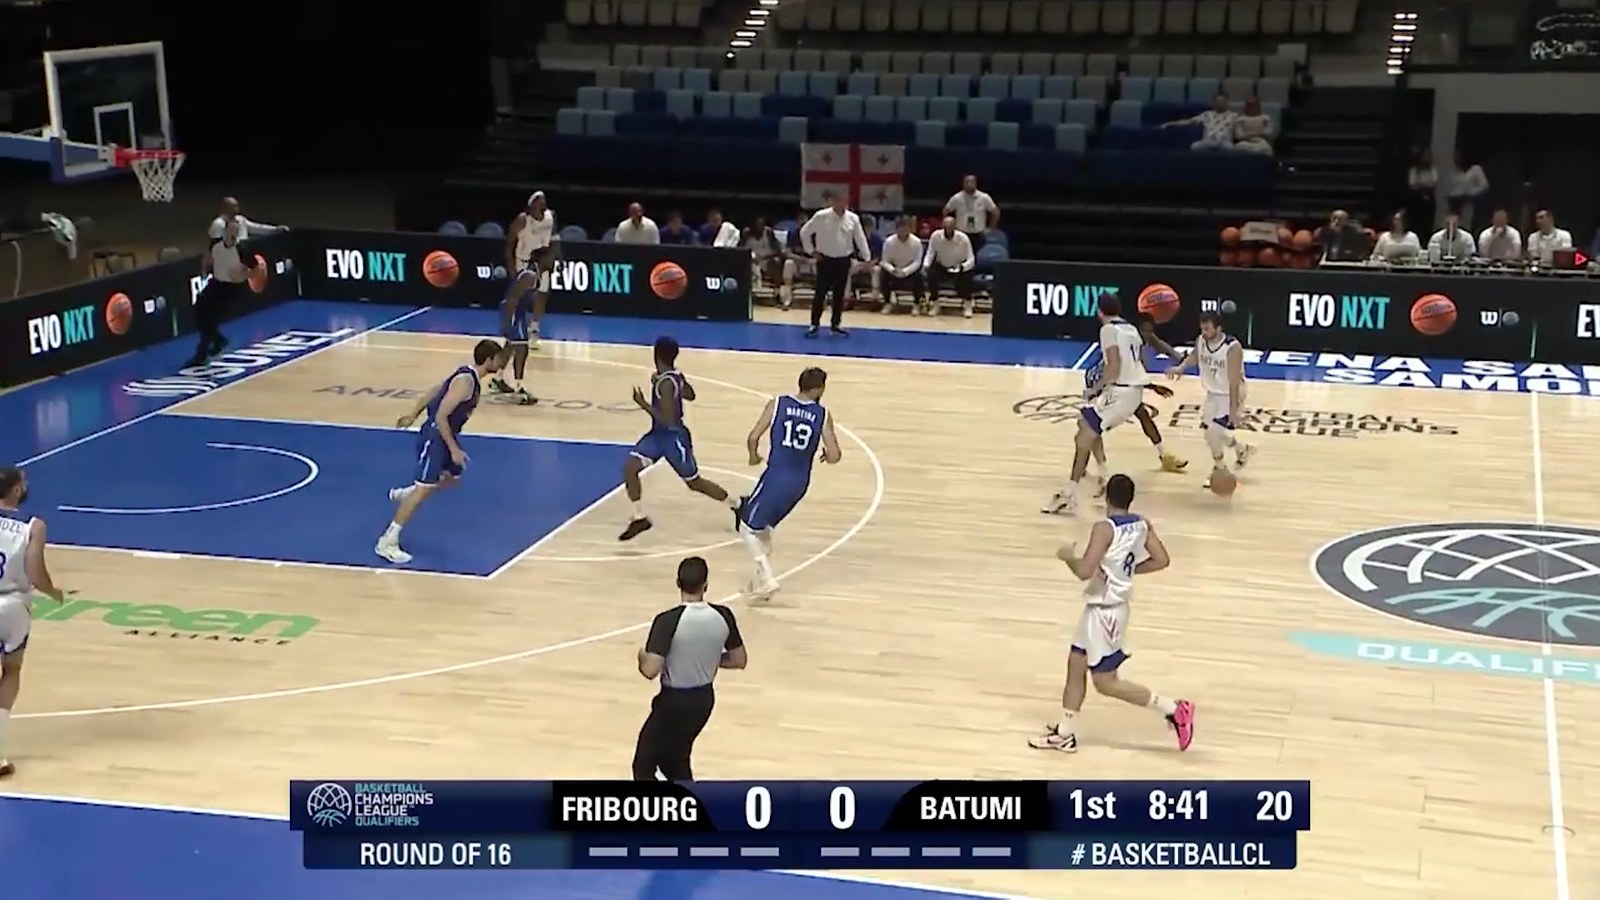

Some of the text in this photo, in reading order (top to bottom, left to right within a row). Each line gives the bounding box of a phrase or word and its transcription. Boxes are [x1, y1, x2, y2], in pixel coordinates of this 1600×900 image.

[326, 248, 407, 282] EVO NXT
[551, 260, 634, 294] EVO NXT
[1026, 282, 1069, 316] EVO
[1288, 293, 1391, 329] EVO NXT
[28, 305, 95, 355] EVO NXT
[782, 420, 812, 450] 13
